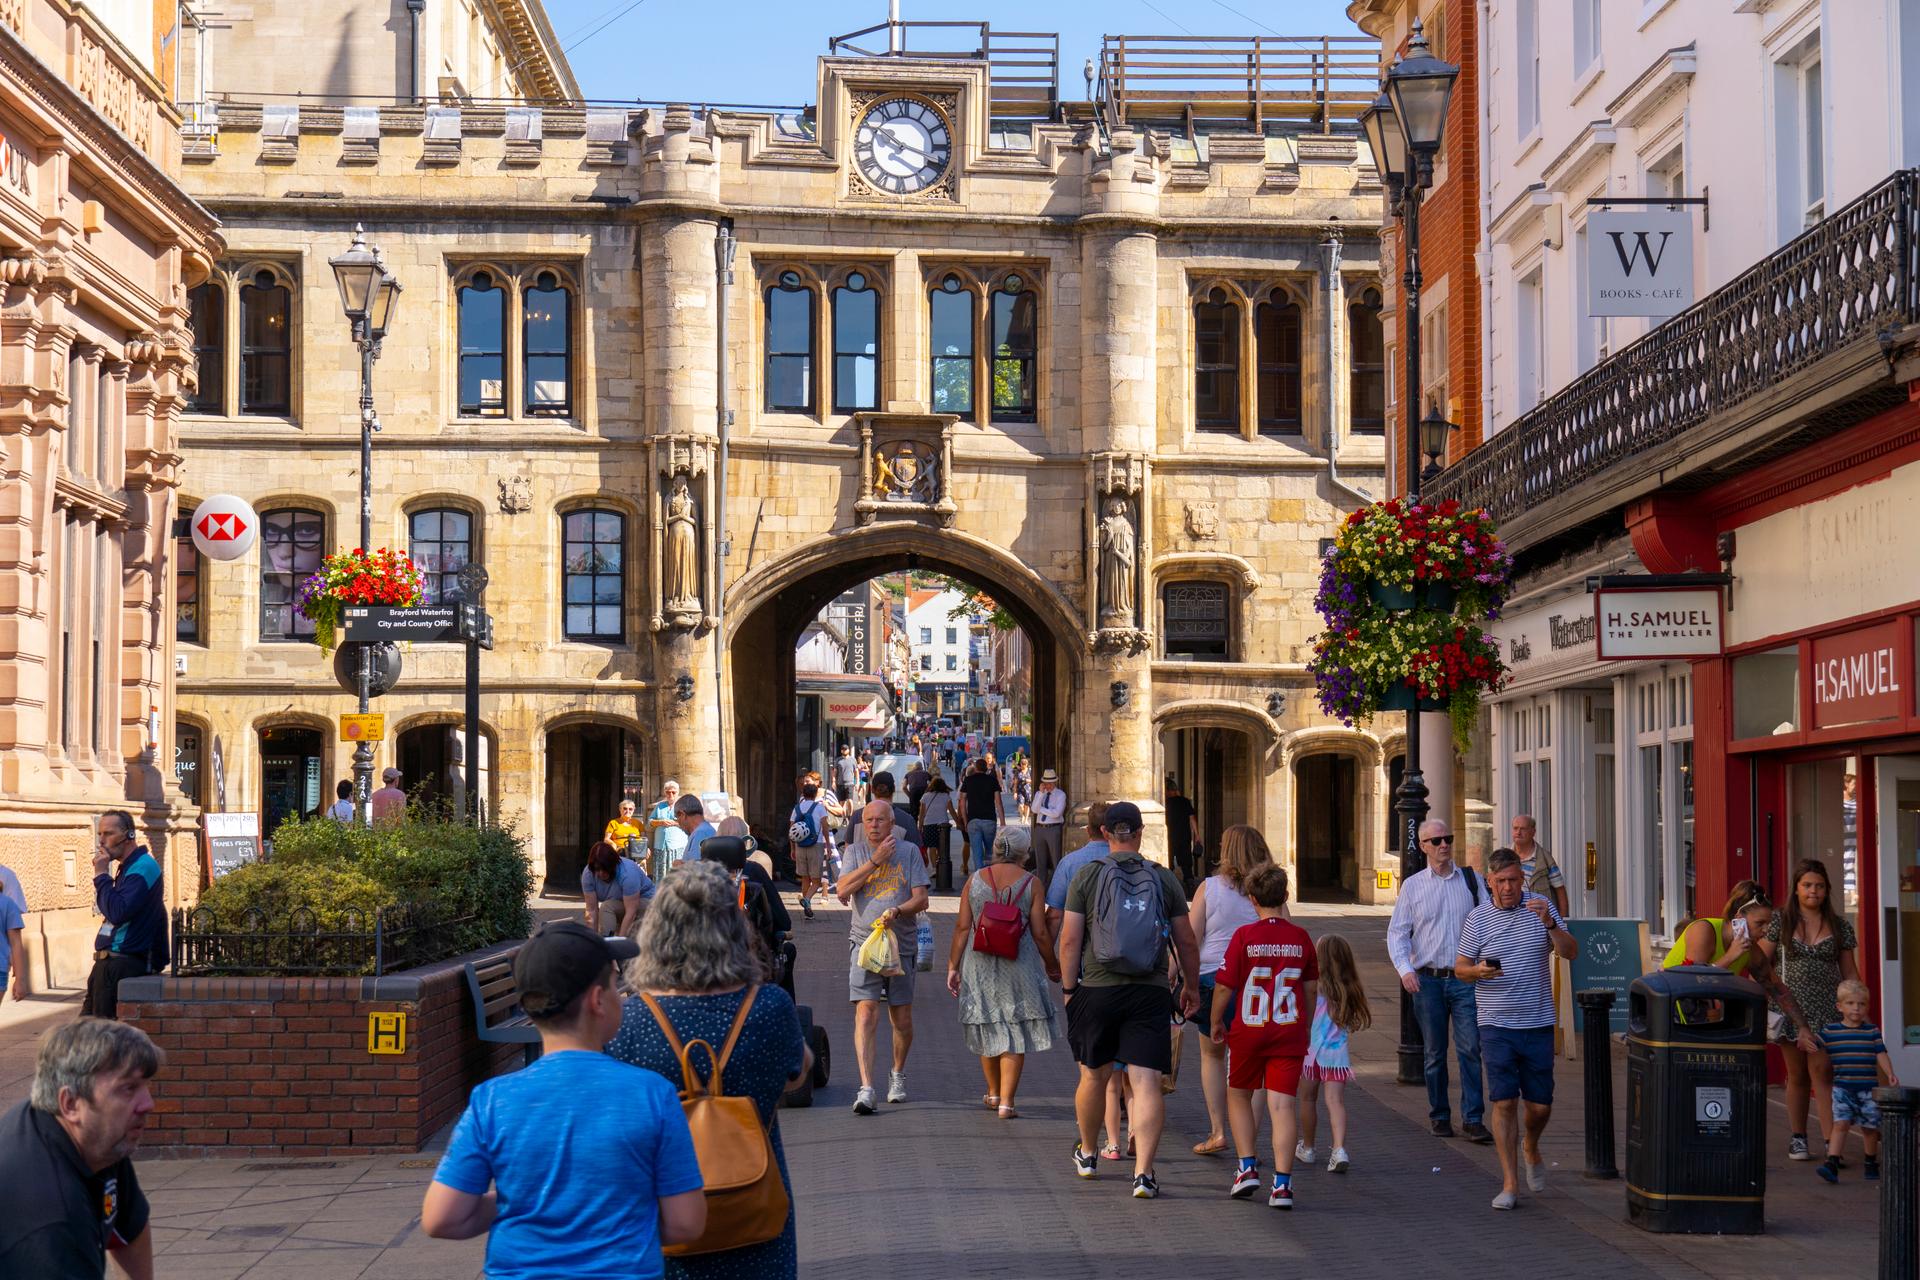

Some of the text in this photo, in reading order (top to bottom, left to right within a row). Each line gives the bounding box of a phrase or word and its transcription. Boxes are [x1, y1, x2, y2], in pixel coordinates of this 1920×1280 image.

[10, 143, 31, 197] UK
[1605, 231, 1674, 278] W
[1600, 287, 1684, 299] BOOKS CAFÉ
[378, 620, 392, 628] City
[408, 620, 432, 628] County
[390, 609, 419, 617] Brayford
[1608, 610, 1712, 627] H.SAMUEL
[854, 625, 864, 640] OF
[1549, 614, 1596, 652] Waterston
[1645, 629, 1712, 638] JEWELLER
[1510, 633, 1530, 664] Books
[1815, 647, 1899, 704] H.SAMUEL
[1407, 819, 1416, 850] 23A
[1597, 944, 1611, 954] W
[1241, 967, 1302, 1027] 66
[374, 1016, 401, 1050] H
[1687, 1054, 1736, 1064] LITTER
